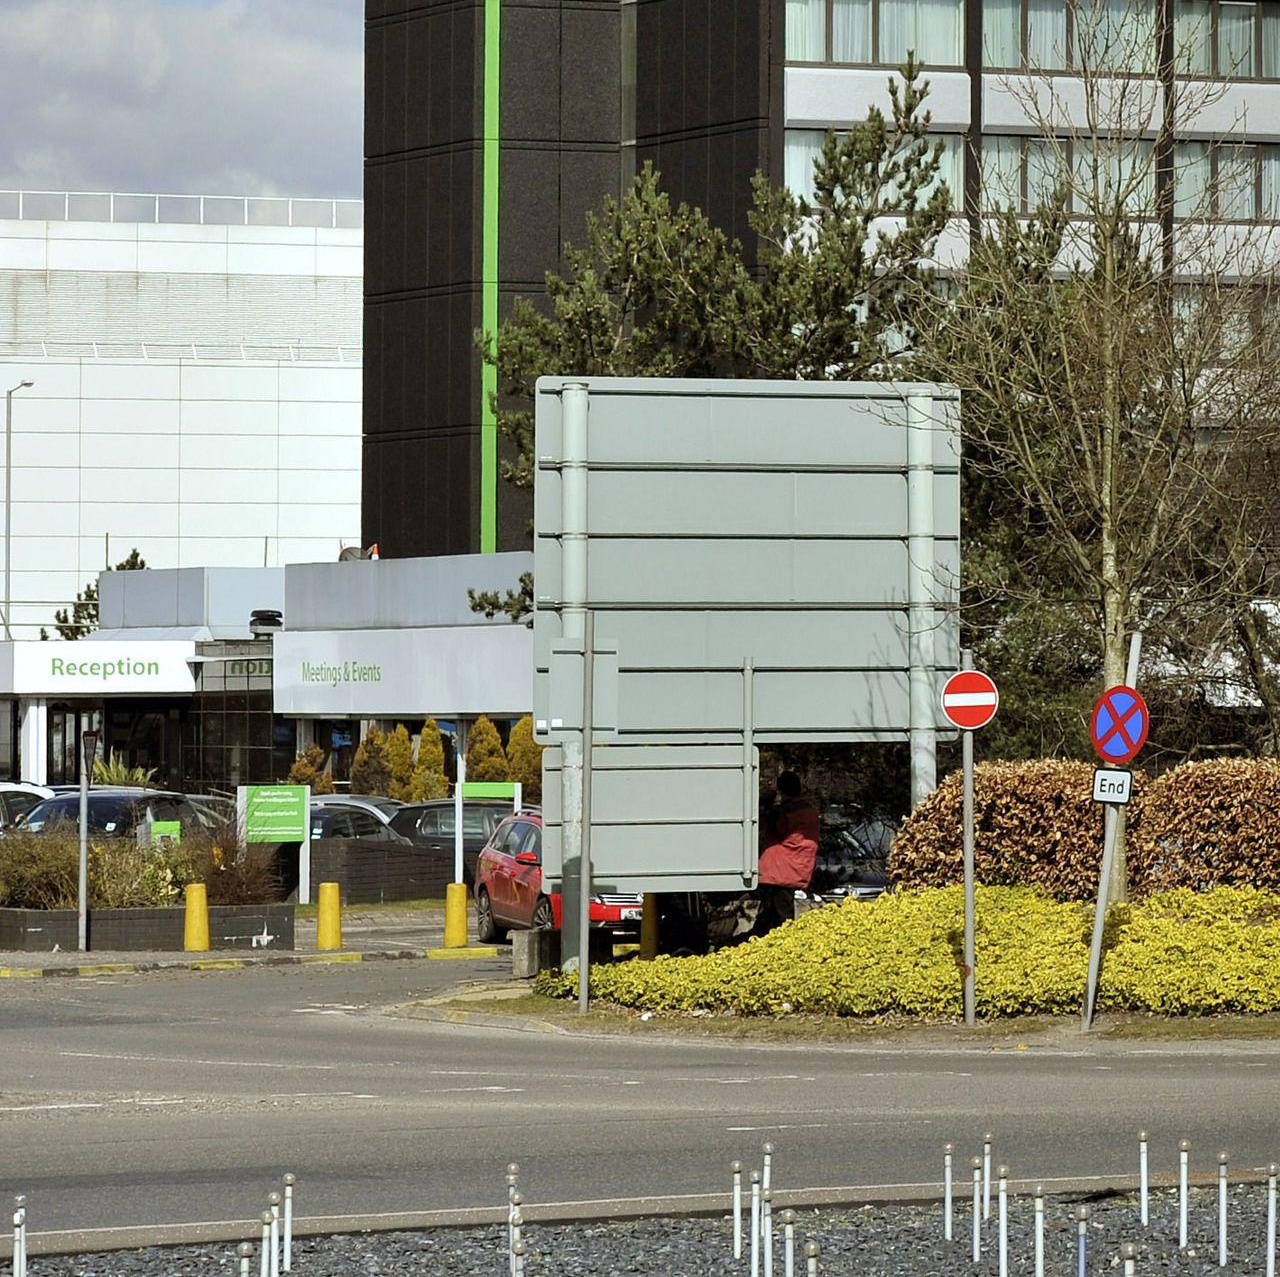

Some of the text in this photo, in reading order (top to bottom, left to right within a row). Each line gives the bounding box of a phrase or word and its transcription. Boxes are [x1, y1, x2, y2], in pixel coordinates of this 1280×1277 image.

[51, 658, 159, 680] Reception
[302, 661, 381, 687] Meetings & Events
[1100, 778, 1124, 794] End
